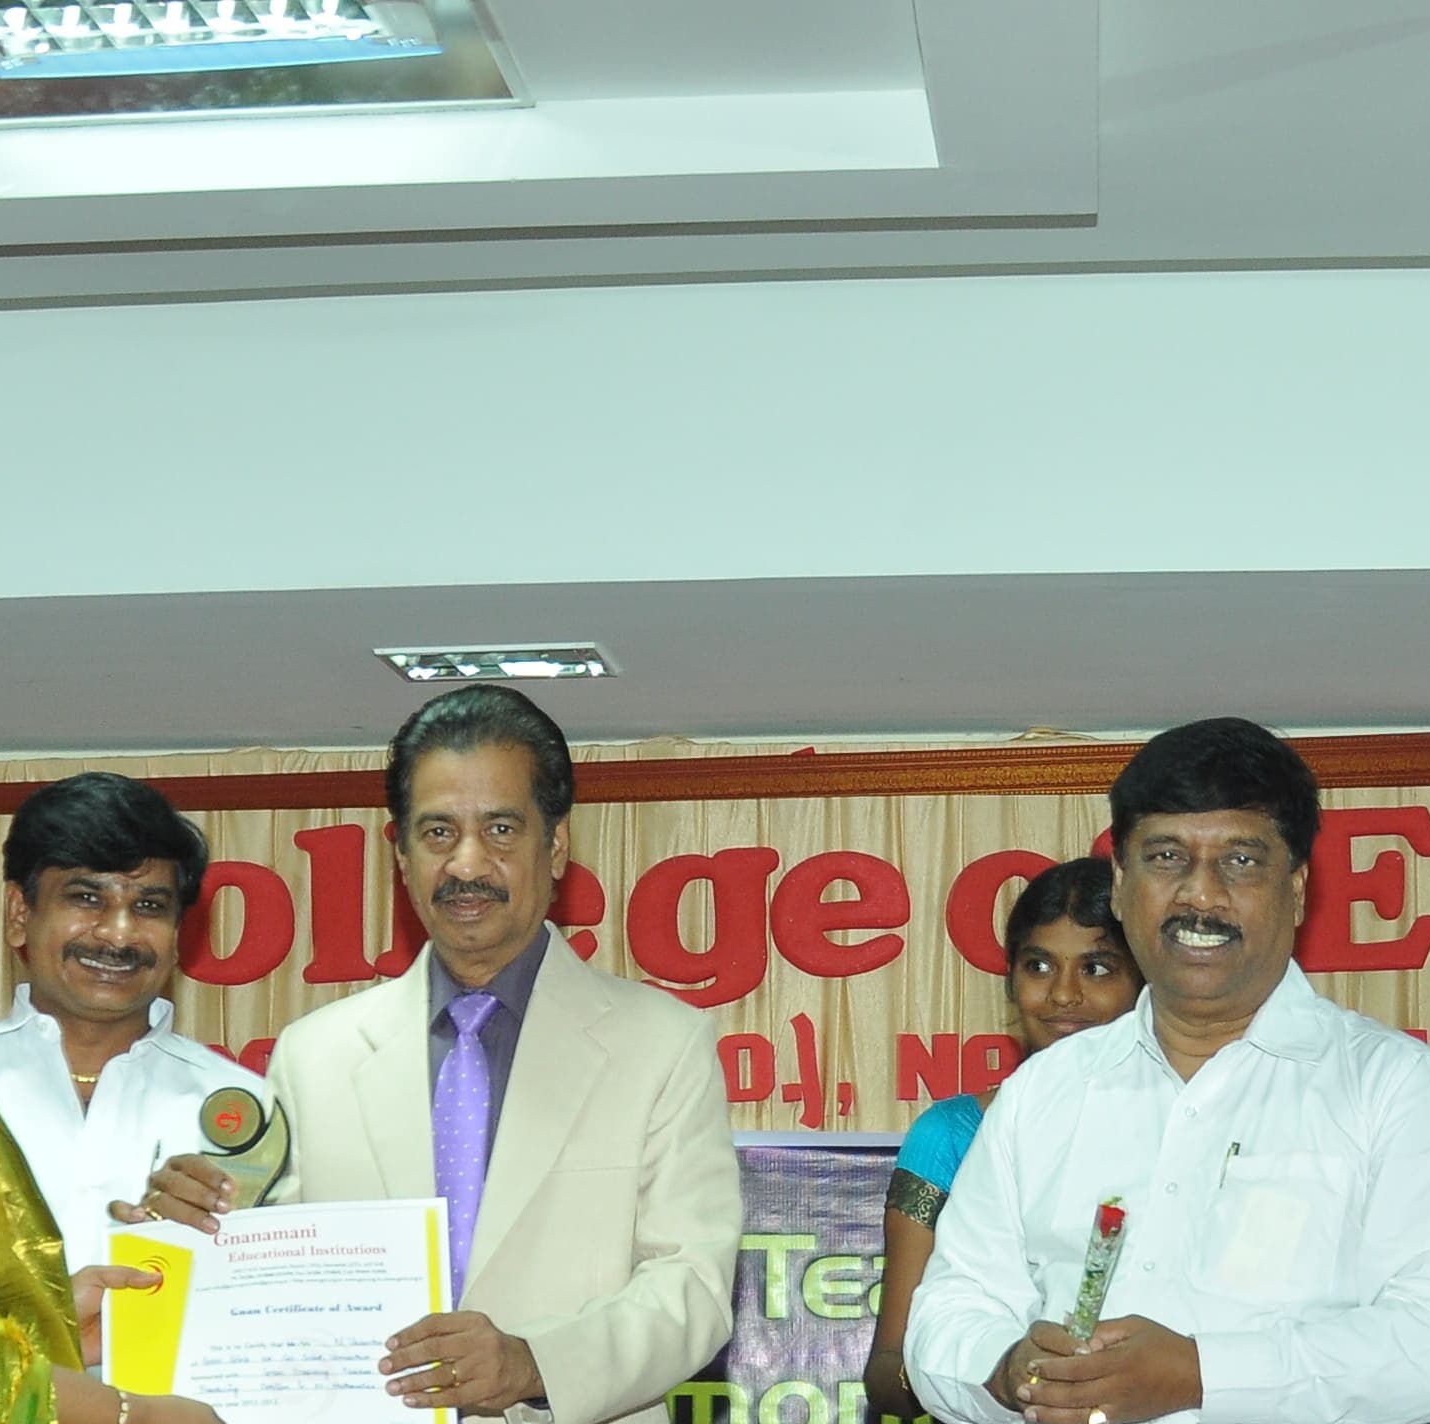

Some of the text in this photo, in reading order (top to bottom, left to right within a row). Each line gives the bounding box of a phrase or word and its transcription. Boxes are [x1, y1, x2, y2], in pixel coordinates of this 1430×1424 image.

[213, 1224, 318, 1248] Gnanamani
[228, 1243, 388, 1264] Educational Institutions
[265, 1303, 326, 1315] Certificate
[328, 1303, 341, 1313] of
[345, 1303, 383, 1313] Award
